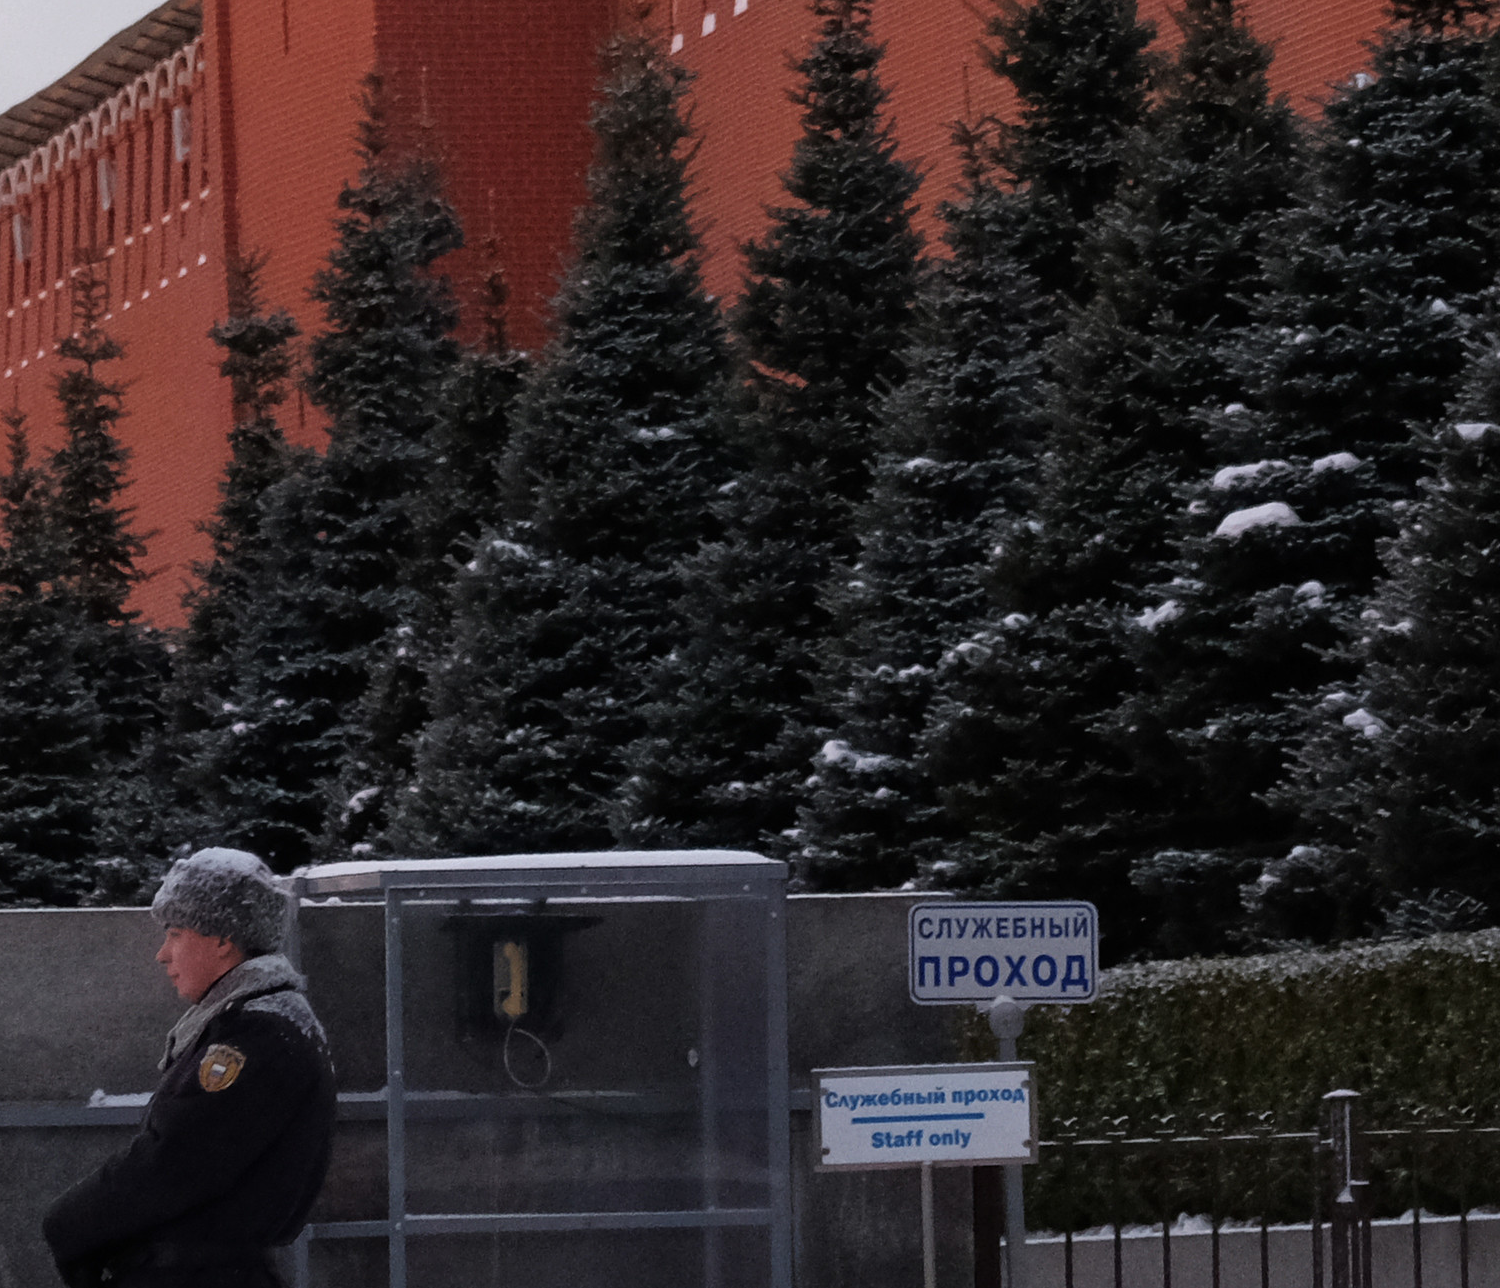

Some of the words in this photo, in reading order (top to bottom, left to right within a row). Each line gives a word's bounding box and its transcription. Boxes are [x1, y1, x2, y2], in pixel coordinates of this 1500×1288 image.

[917, 912, 1089, 939] СЛУЖЕБНЫЙ
[918, 954, 1090, 992] ПРОХОД
[825, 1087, 946, 1111] Служебный
[952, 1087, 1026, 1105] проход
[871, 1130, 924, 1150] Staff
[928, 1129, 972, 1149] only
